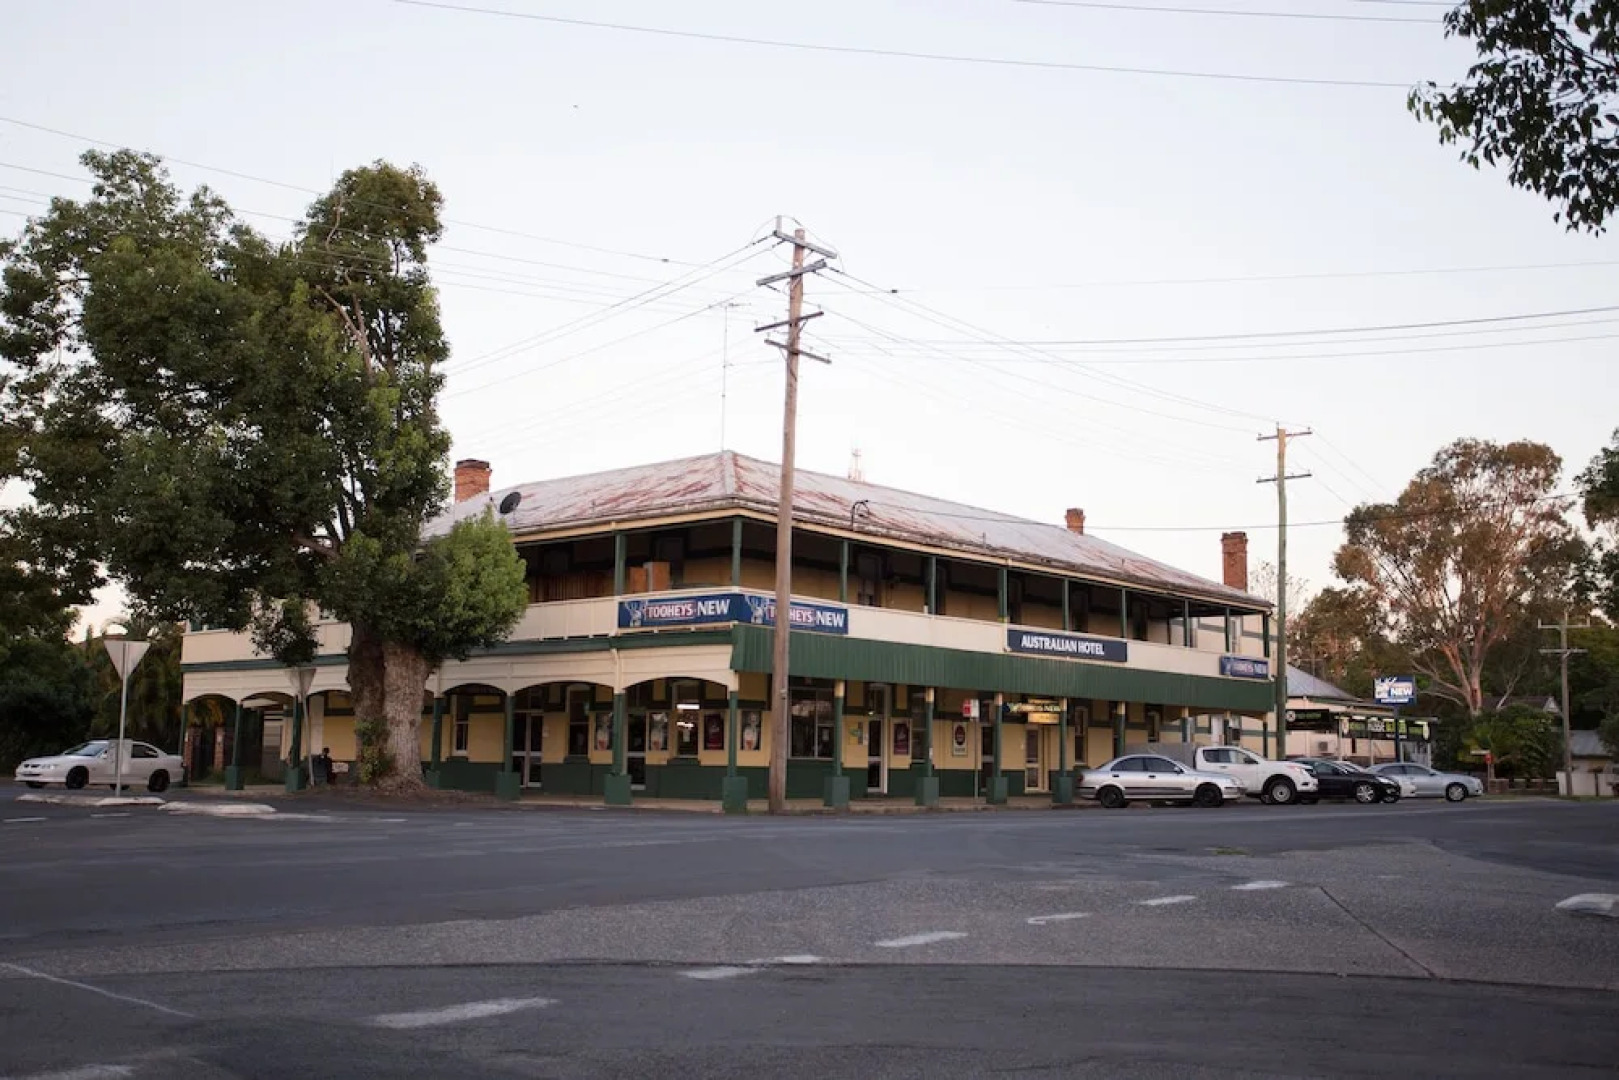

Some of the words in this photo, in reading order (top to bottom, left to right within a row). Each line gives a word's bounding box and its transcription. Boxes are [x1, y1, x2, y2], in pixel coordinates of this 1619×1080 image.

[648, 604, 692, 618] TOOHEYS
[697, 599, 730, 616] NEW
[768, 606, 813, 623] THEYS
[816, 610, 845, 627] NEW
[1021, 635, 1077, 652] AUSTRALIAN
[1078, 643, 1104, 655] HOTEL
